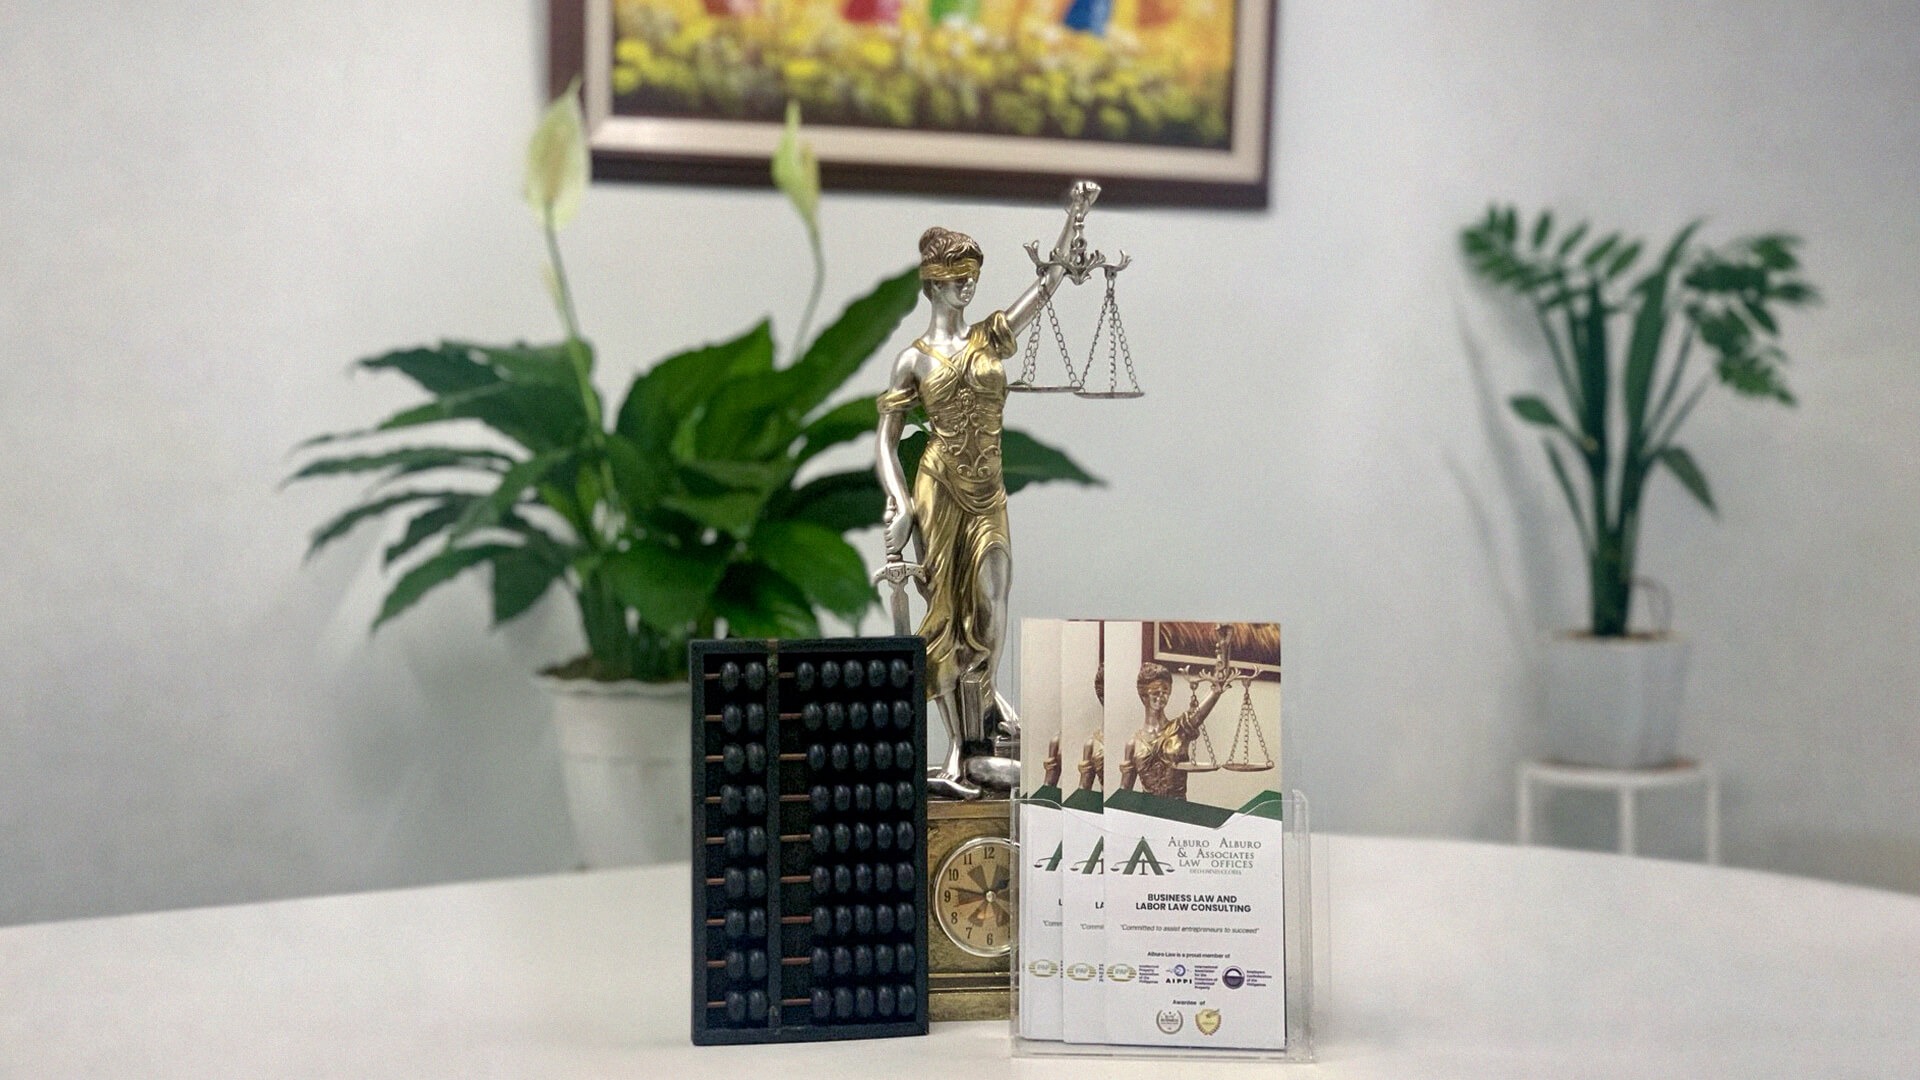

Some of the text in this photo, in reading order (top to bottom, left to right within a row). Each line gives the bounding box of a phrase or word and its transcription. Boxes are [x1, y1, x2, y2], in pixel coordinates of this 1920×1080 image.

[1168, 837, 1262, 849] ALBURO ALBURO
[963, 853, 973, 866] 11
[983, 847, 995, 860] 12
[1177, 848, 1255, 860] & ASSOCIATES
[1179, 859, 1254, 869] LAW OFFICES
[948, 869, 959, 882] 10
[944, 890, 952, 903] 9
[1147, 893, 1238, 904] BUSINESS LAW AND
[1135, 902, 1252, 913] LABOR LAW CONSULTING
[951, 912, 958, 925] 8
[965, 927, 973, 940] 7
[986, 933, 994, 946] 6
